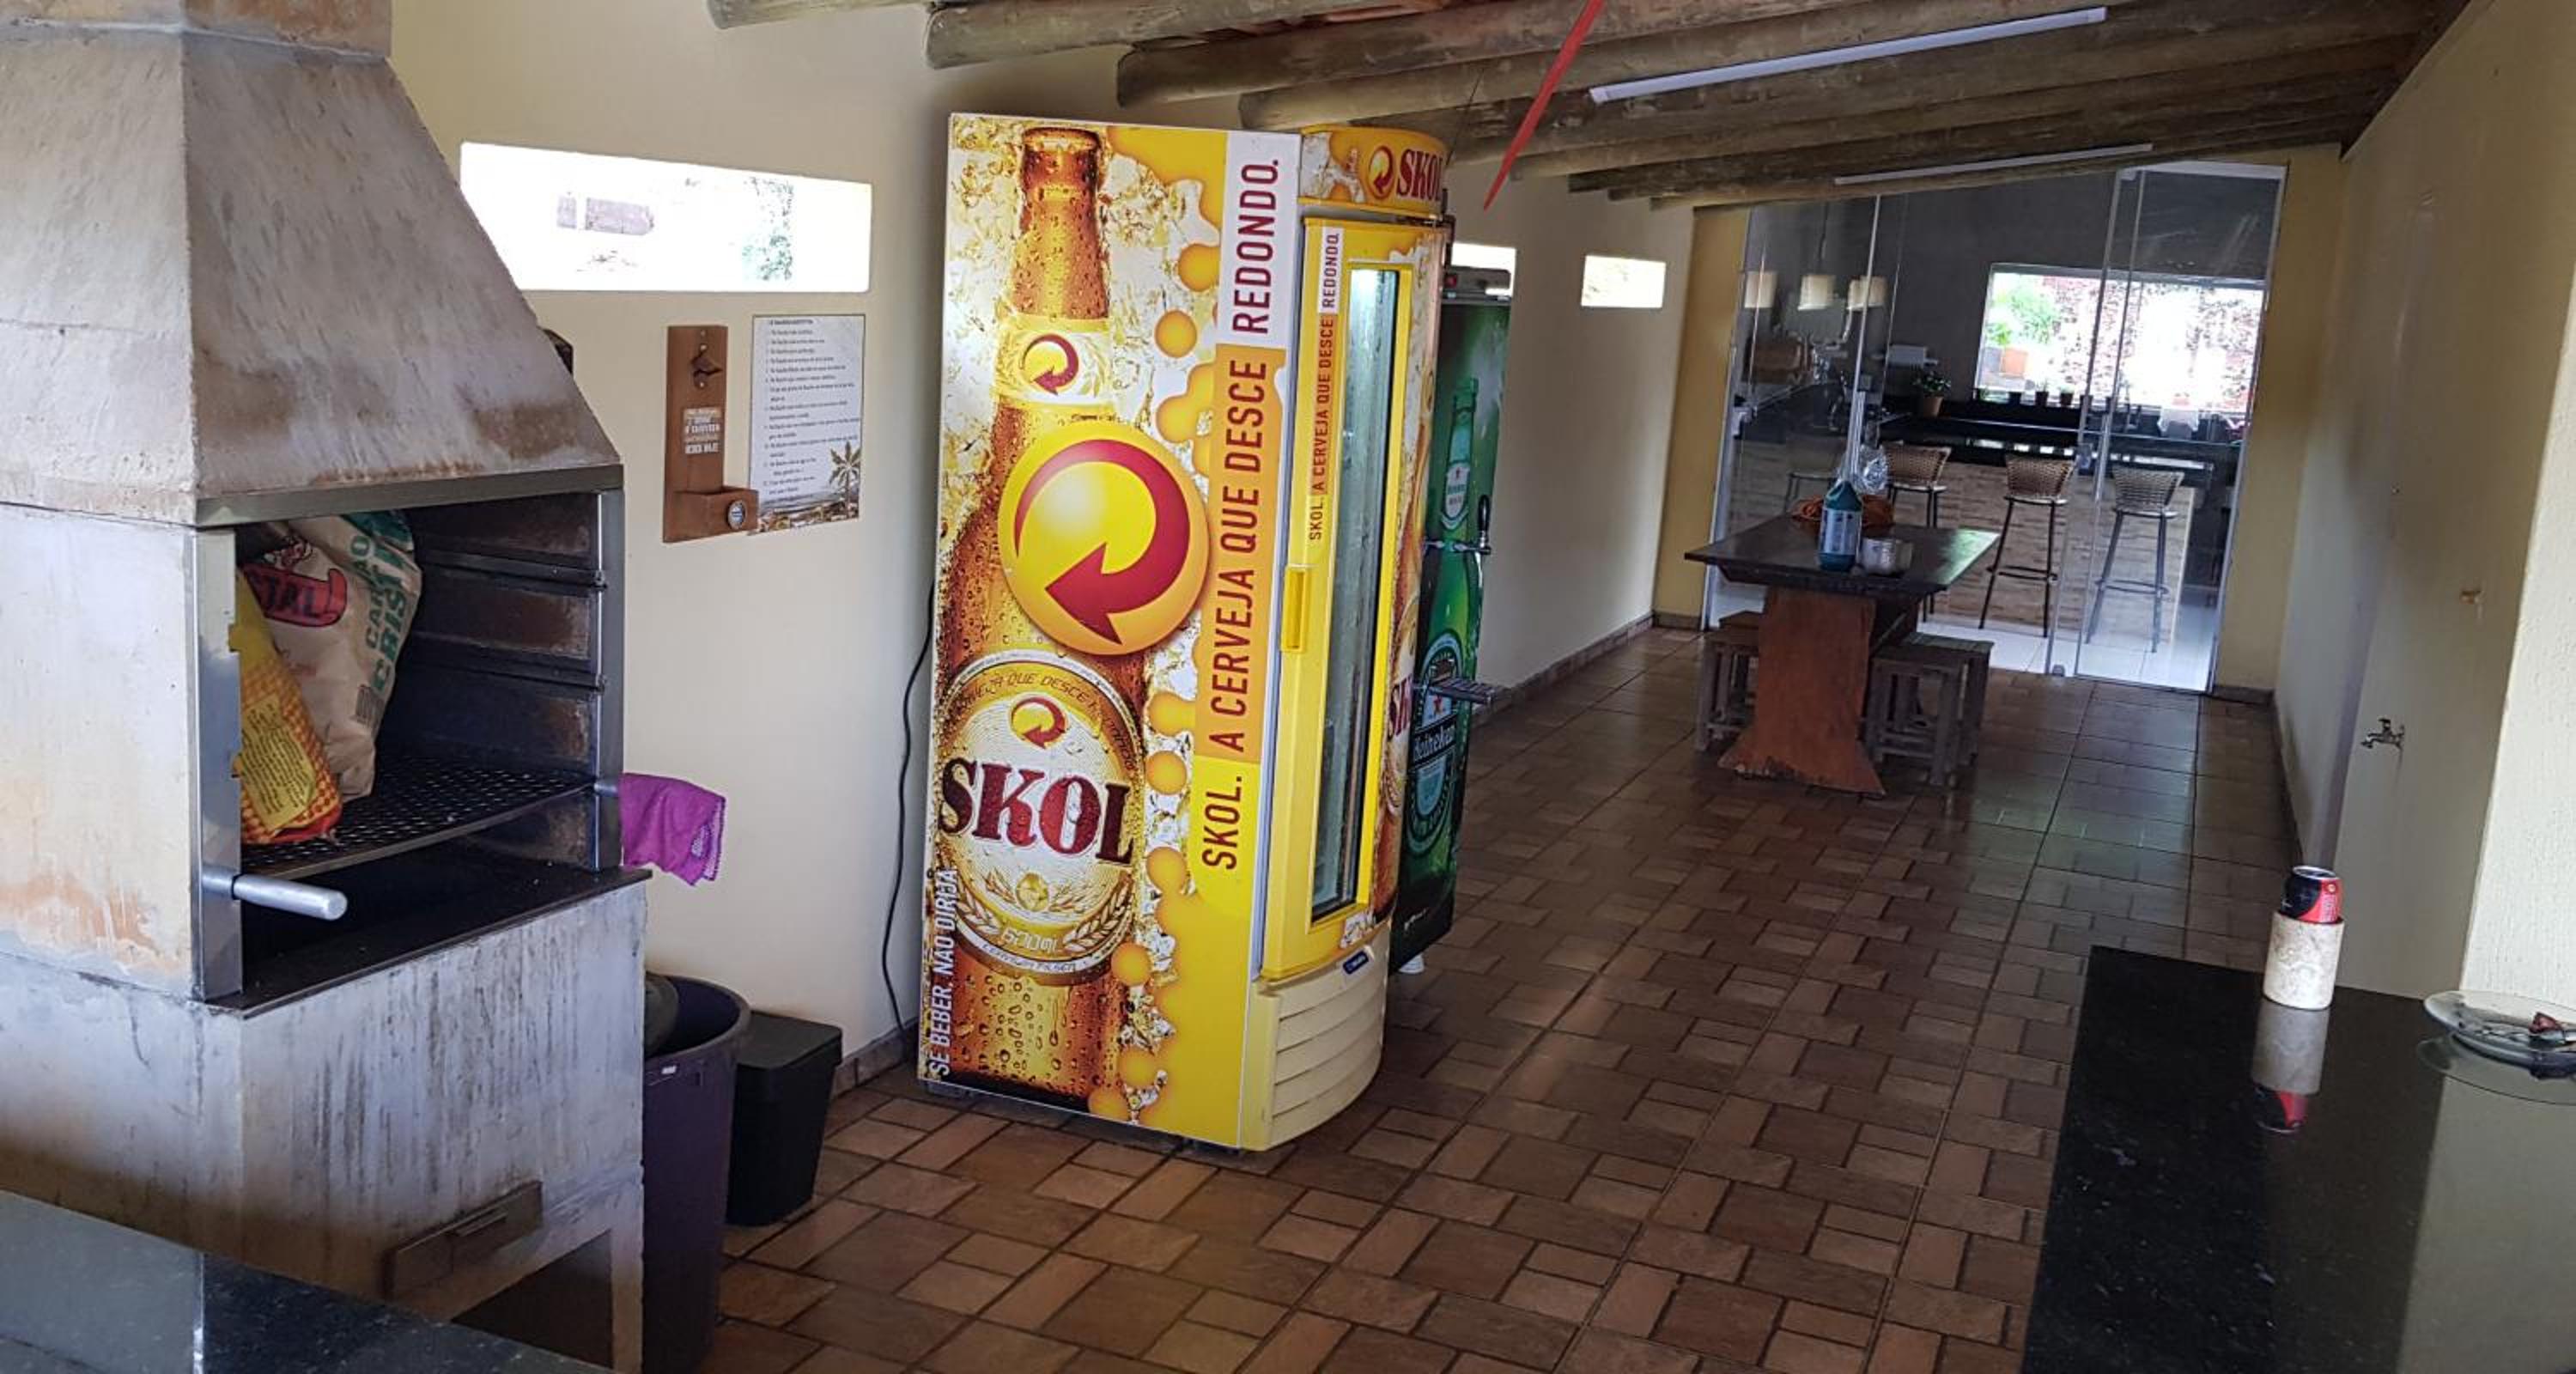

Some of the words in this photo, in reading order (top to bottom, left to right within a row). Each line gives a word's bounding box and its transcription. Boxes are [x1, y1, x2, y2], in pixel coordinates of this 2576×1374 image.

[1231, 160, 1279, 335] REDONDO.
[1318, 318, 1334, 368] DESCE
[1224, 359, 1267, 473] DESCE
[1316, 372, 1331, 404] QUE
[1313, 409, 1329, 475] CERVEJA
[1219, 485, 1260, 554] QUE
[1311, 483, 1326, 494] A
[1210, 569, 1255, 716] CERVEJA
[1006, 672, 1037, 687] QUE
[1040, 675, 1091, 702] DESCE
[1209, 733, 1245, 753] A
[938, 757, 1134, 865] SKOL
[1201, 775, 1242, 870] SKOL.
[929, 1049, 951, 1076] SE
